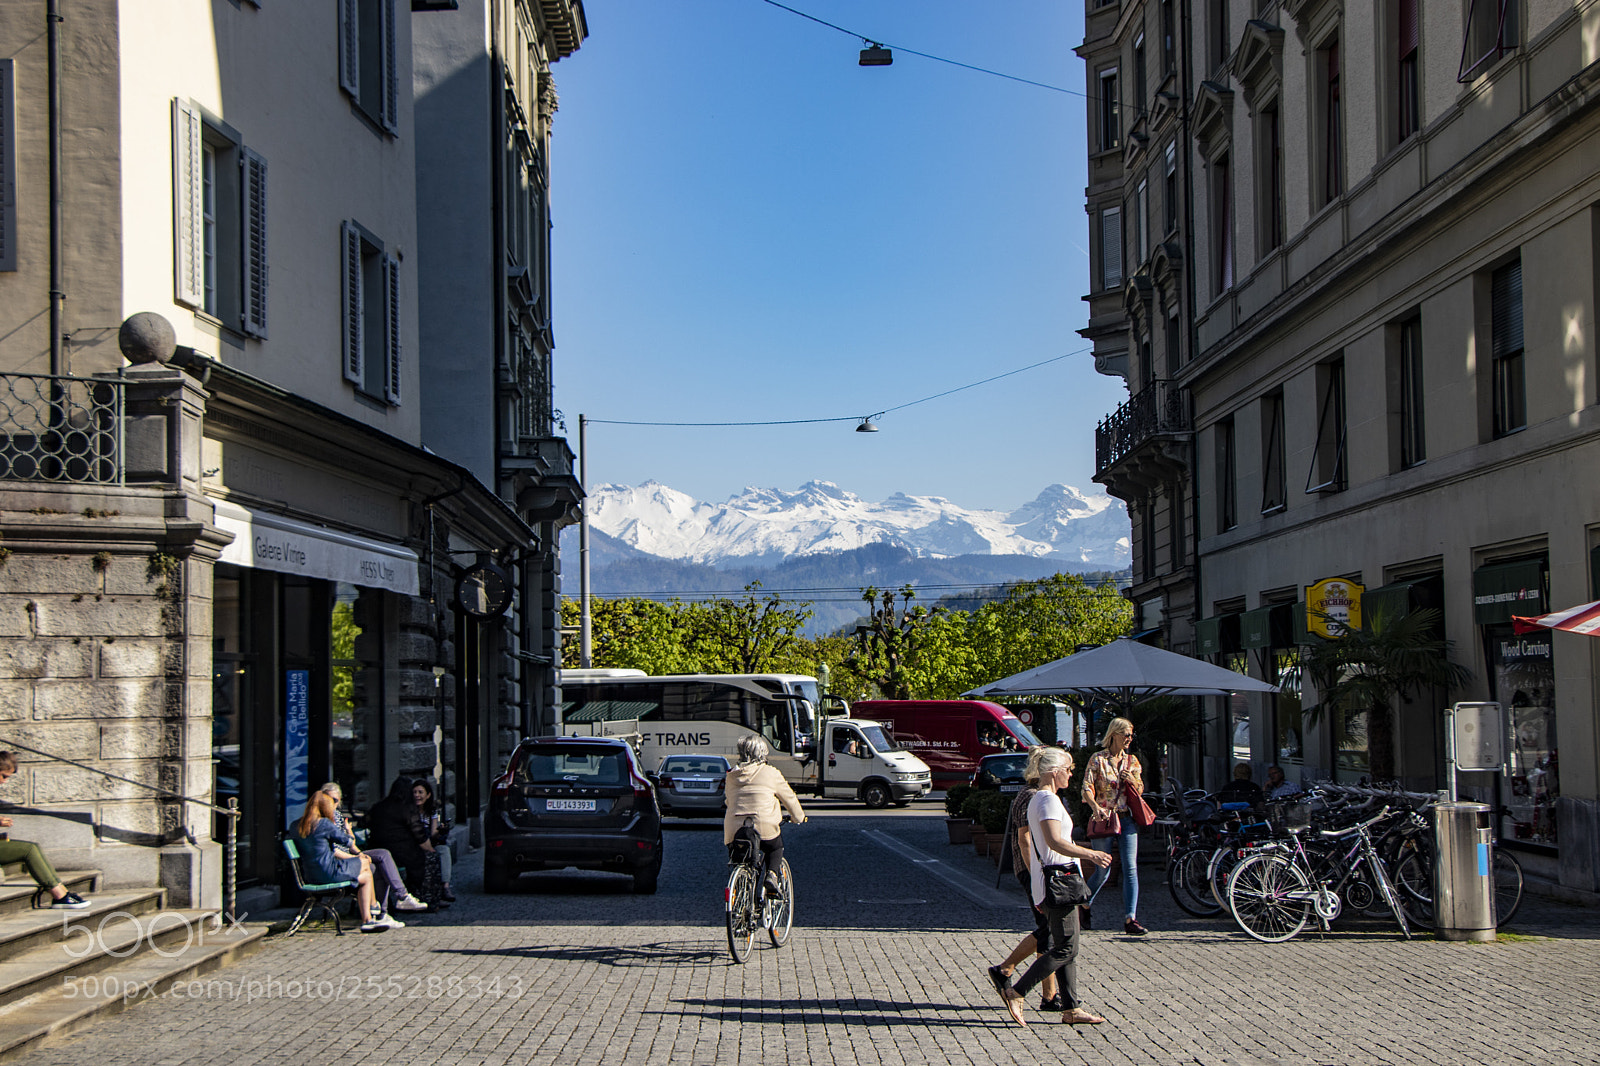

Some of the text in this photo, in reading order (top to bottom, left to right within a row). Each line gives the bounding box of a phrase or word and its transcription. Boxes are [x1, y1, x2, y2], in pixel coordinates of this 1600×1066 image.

[360, 560, 377, 579] HESS
[1501, 639, 1550, 658] Wood Carving
[298, 685, 307, 720] Bellido
[655, 732, 711, 746] TRANS
